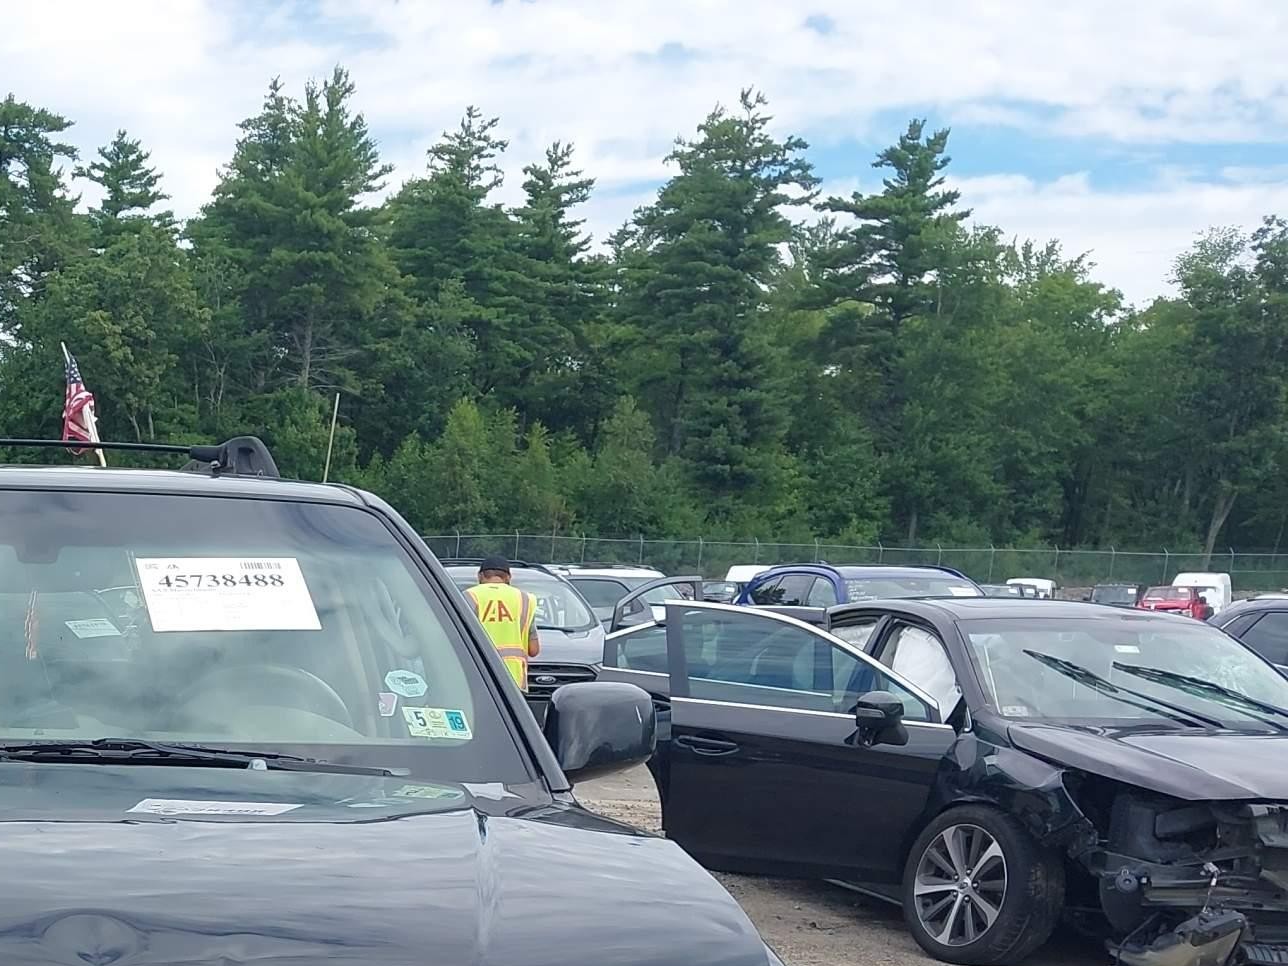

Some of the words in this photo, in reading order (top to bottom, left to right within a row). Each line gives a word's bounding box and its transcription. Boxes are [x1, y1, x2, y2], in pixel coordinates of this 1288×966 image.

[158, 573, 285, 588] 45738488
[413, 711, 427, 727] 5
[447, 716, 465, 730] 19
